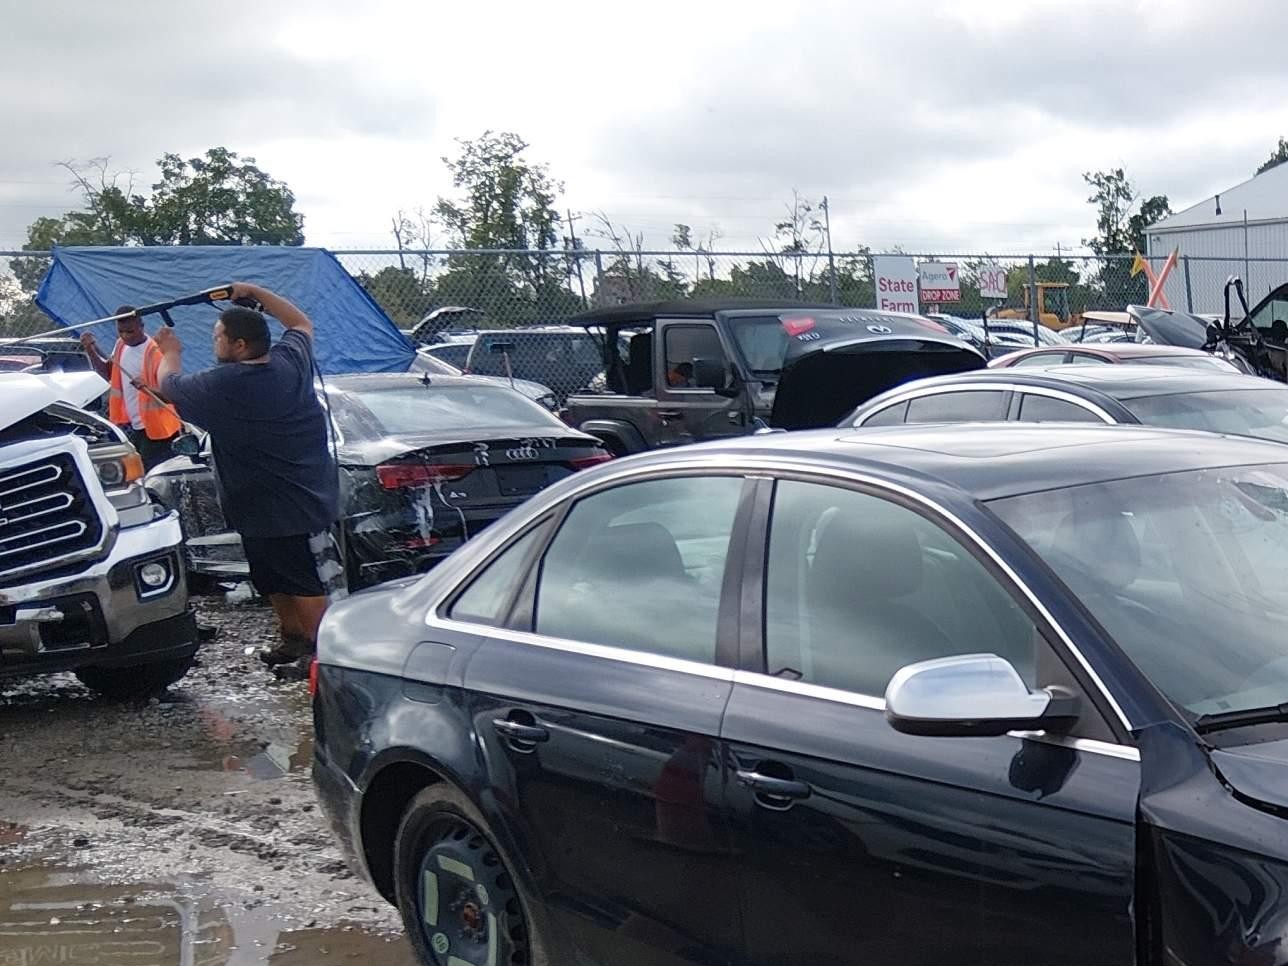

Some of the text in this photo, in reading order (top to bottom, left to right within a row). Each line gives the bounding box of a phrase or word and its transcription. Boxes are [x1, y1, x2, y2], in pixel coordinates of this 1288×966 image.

[922, 272, 947, 281] Agero
[879, 277, 914, 293] State
[922, 290, 960, 302] DROP ZONE
[881, 299, 915, 314] Farm
